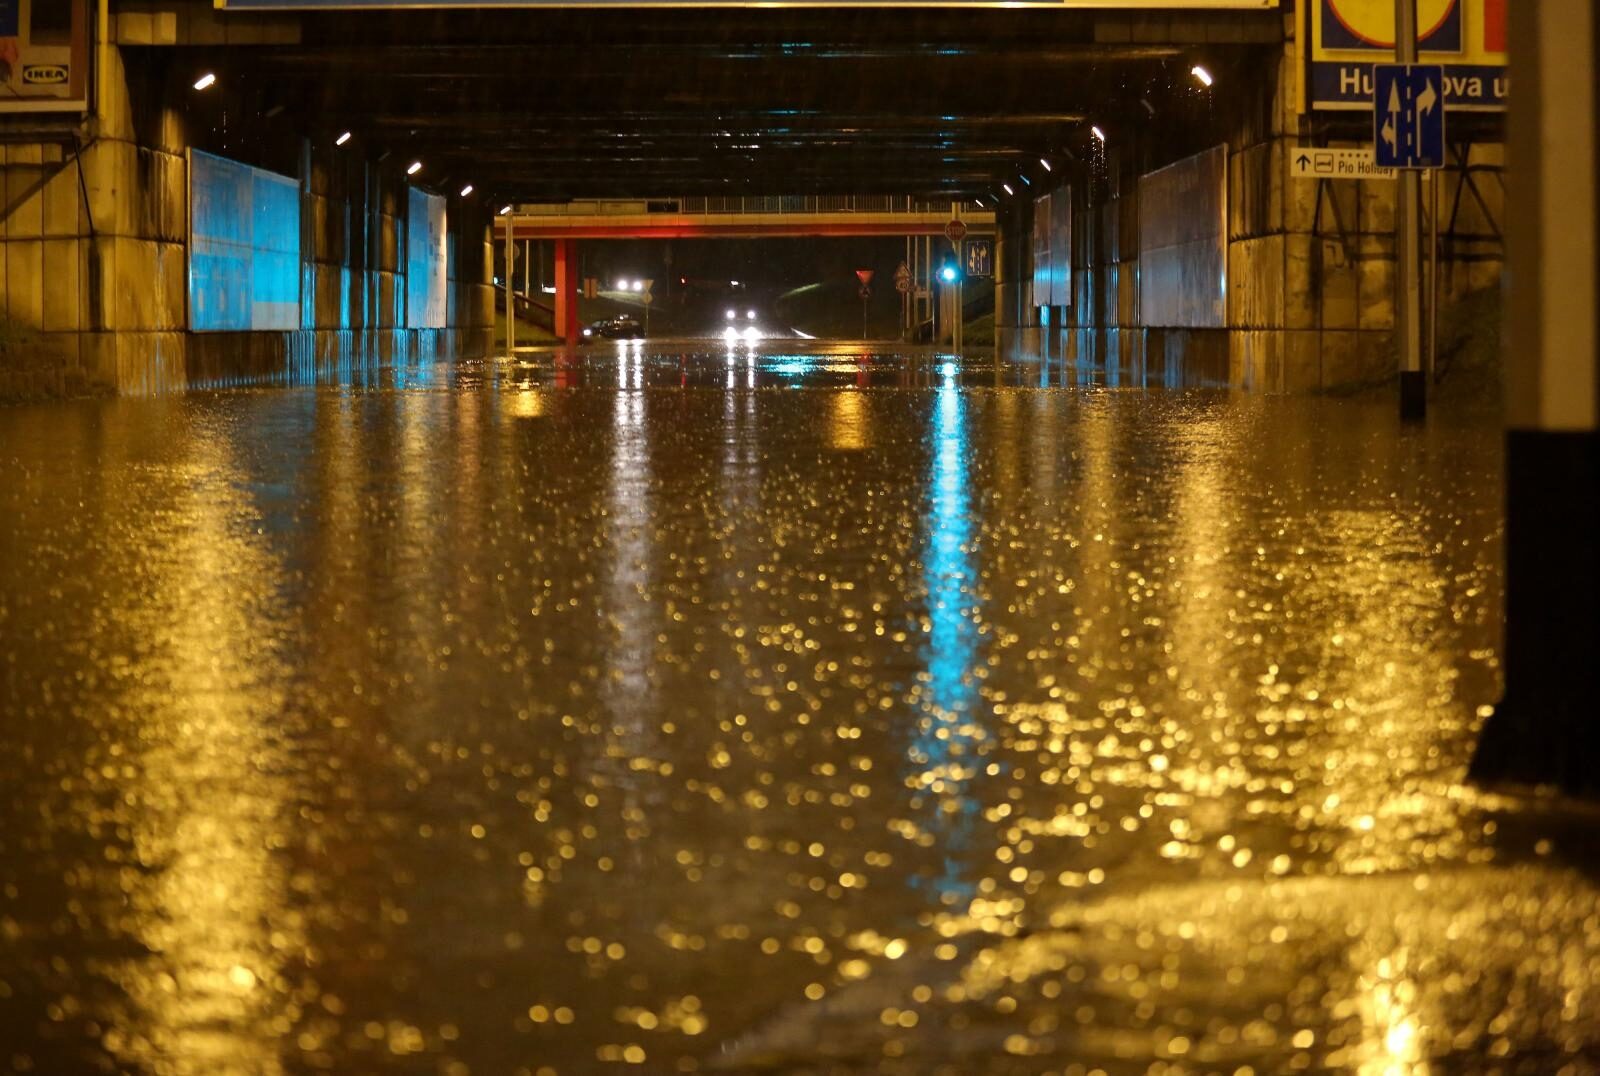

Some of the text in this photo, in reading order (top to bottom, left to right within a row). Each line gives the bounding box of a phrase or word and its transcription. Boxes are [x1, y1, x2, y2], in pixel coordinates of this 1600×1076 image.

[26, 69, 66, 80] IKEA
[1338, 161, 1354, 174] Pio
[946, 226, 965, 235] STOP
